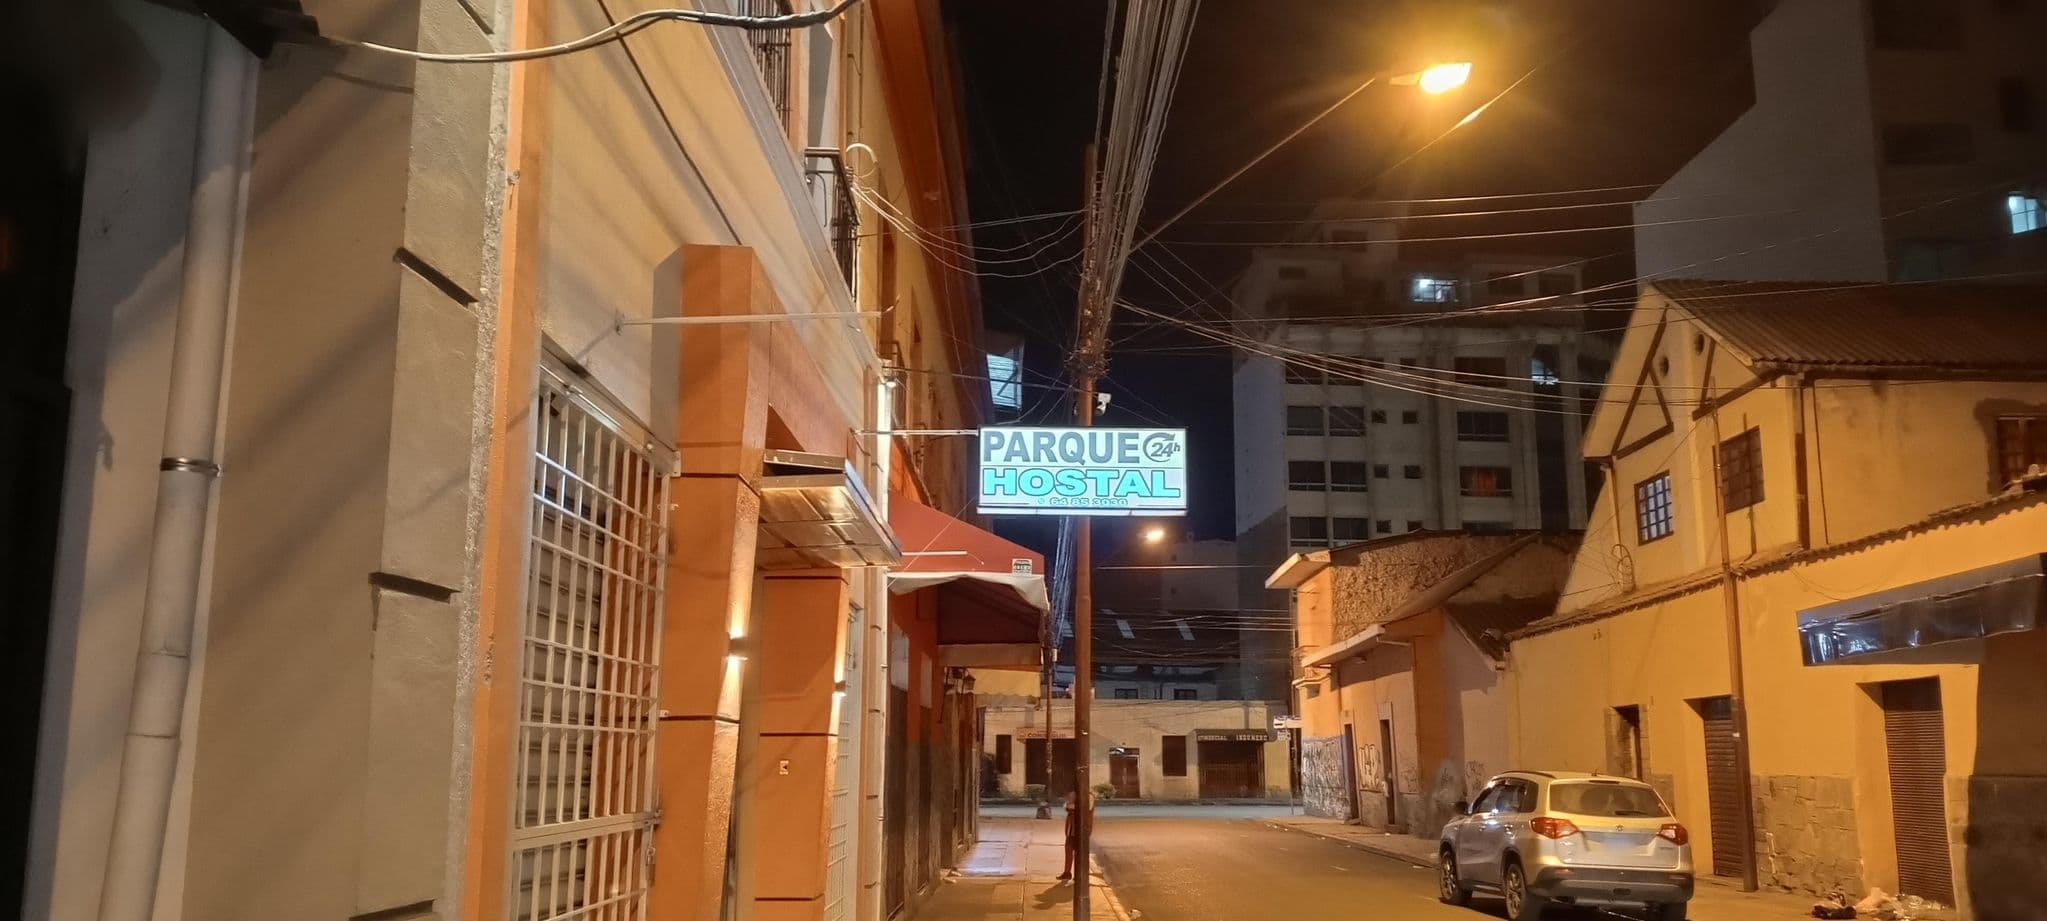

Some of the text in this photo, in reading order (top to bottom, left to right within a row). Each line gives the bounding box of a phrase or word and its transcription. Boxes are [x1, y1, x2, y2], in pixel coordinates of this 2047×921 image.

[983, 431, 1181, 465] PARQUE 24h
[983, 468, 1181, 498] HOSTAL
